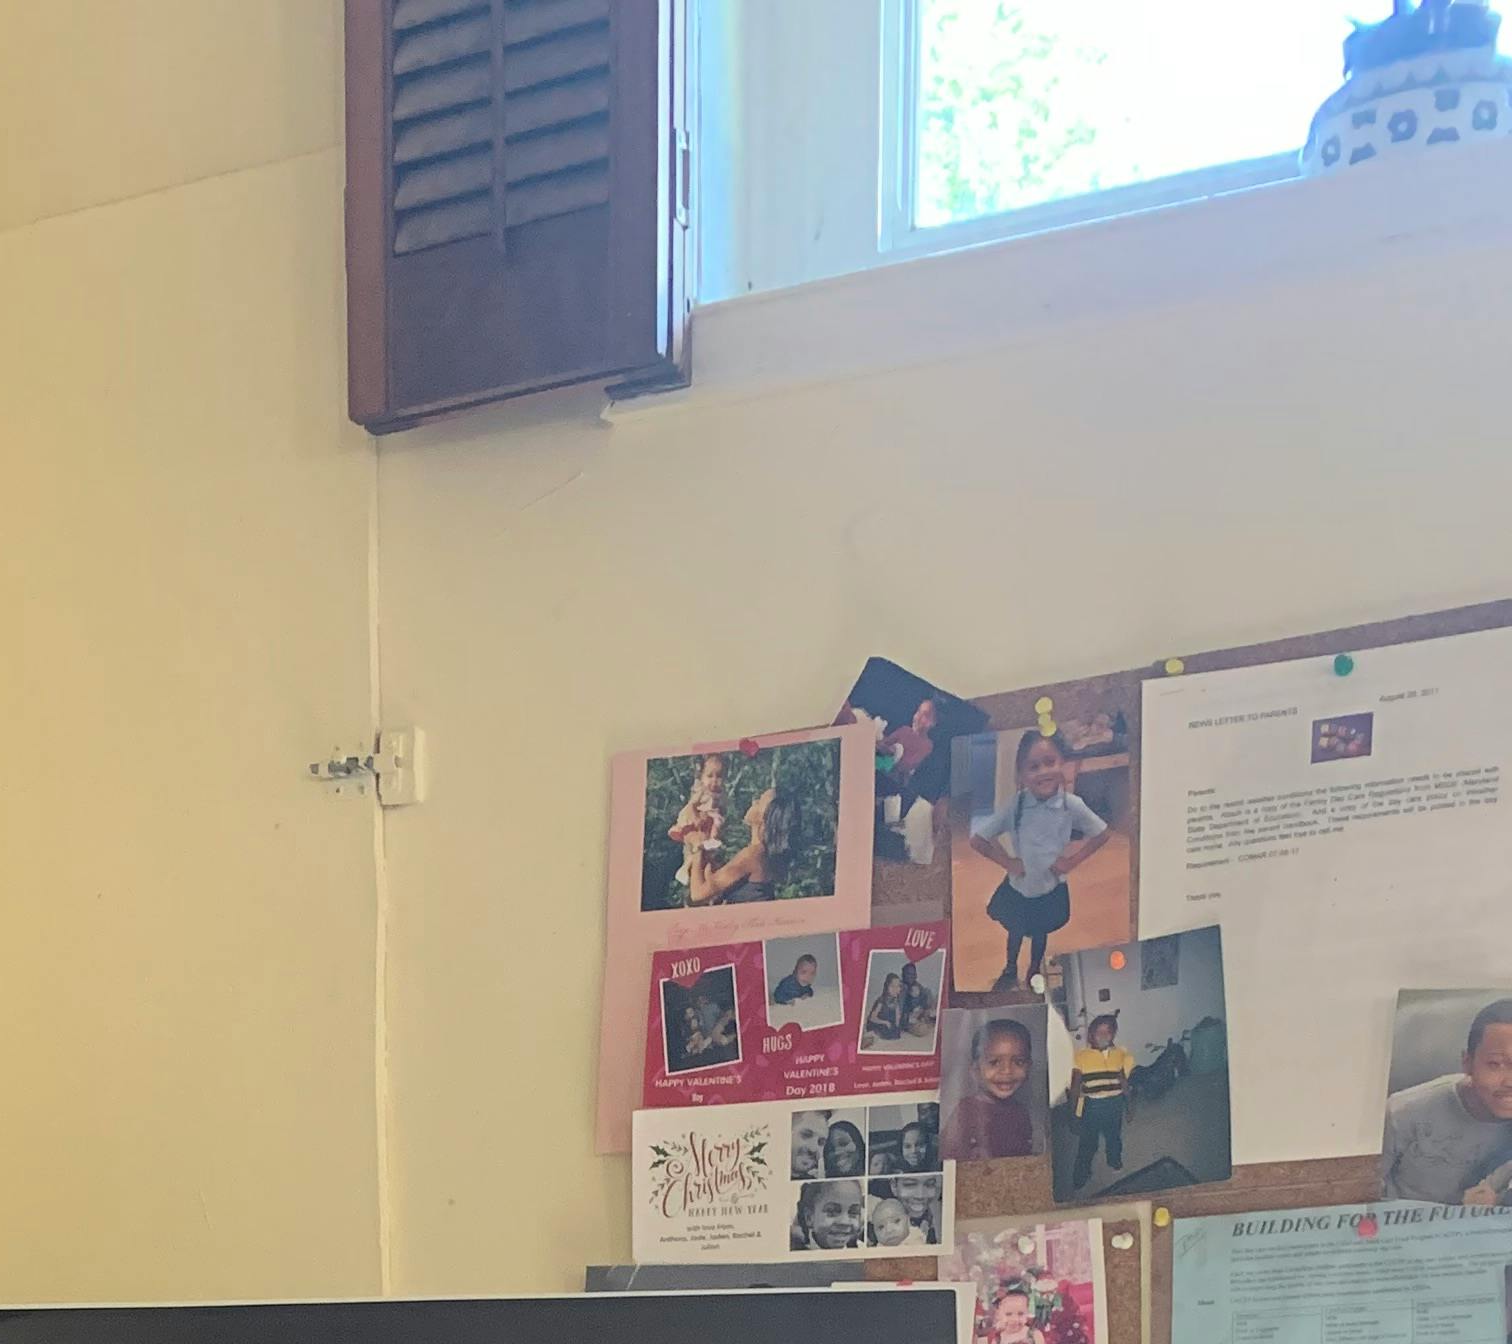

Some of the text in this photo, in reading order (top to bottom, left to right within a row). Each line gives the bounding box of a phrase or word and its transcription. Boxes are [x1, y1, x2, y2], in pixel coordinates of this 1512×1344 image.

[905, 927, 936, 950] LOVE
[671, 957, 701, 979] XOXO
[762, 1034, 793, 1054] HUGS
[795, 1053, 825, 1065] HAPPY
[655, 1075, 742, 1089] HAPPY VALENTINE'S
[786, 1085, 808, 1097] Day
[690, 1131, 741, 1178] Merry
[662, 1159, 752, 1218] Christmas
[688, 1203, 769, 1218] HAPPY NEW YEAR
[1231, 1213, 1331, 1238] BUILDING
[1383, 1206, 1423, 1226] THE
